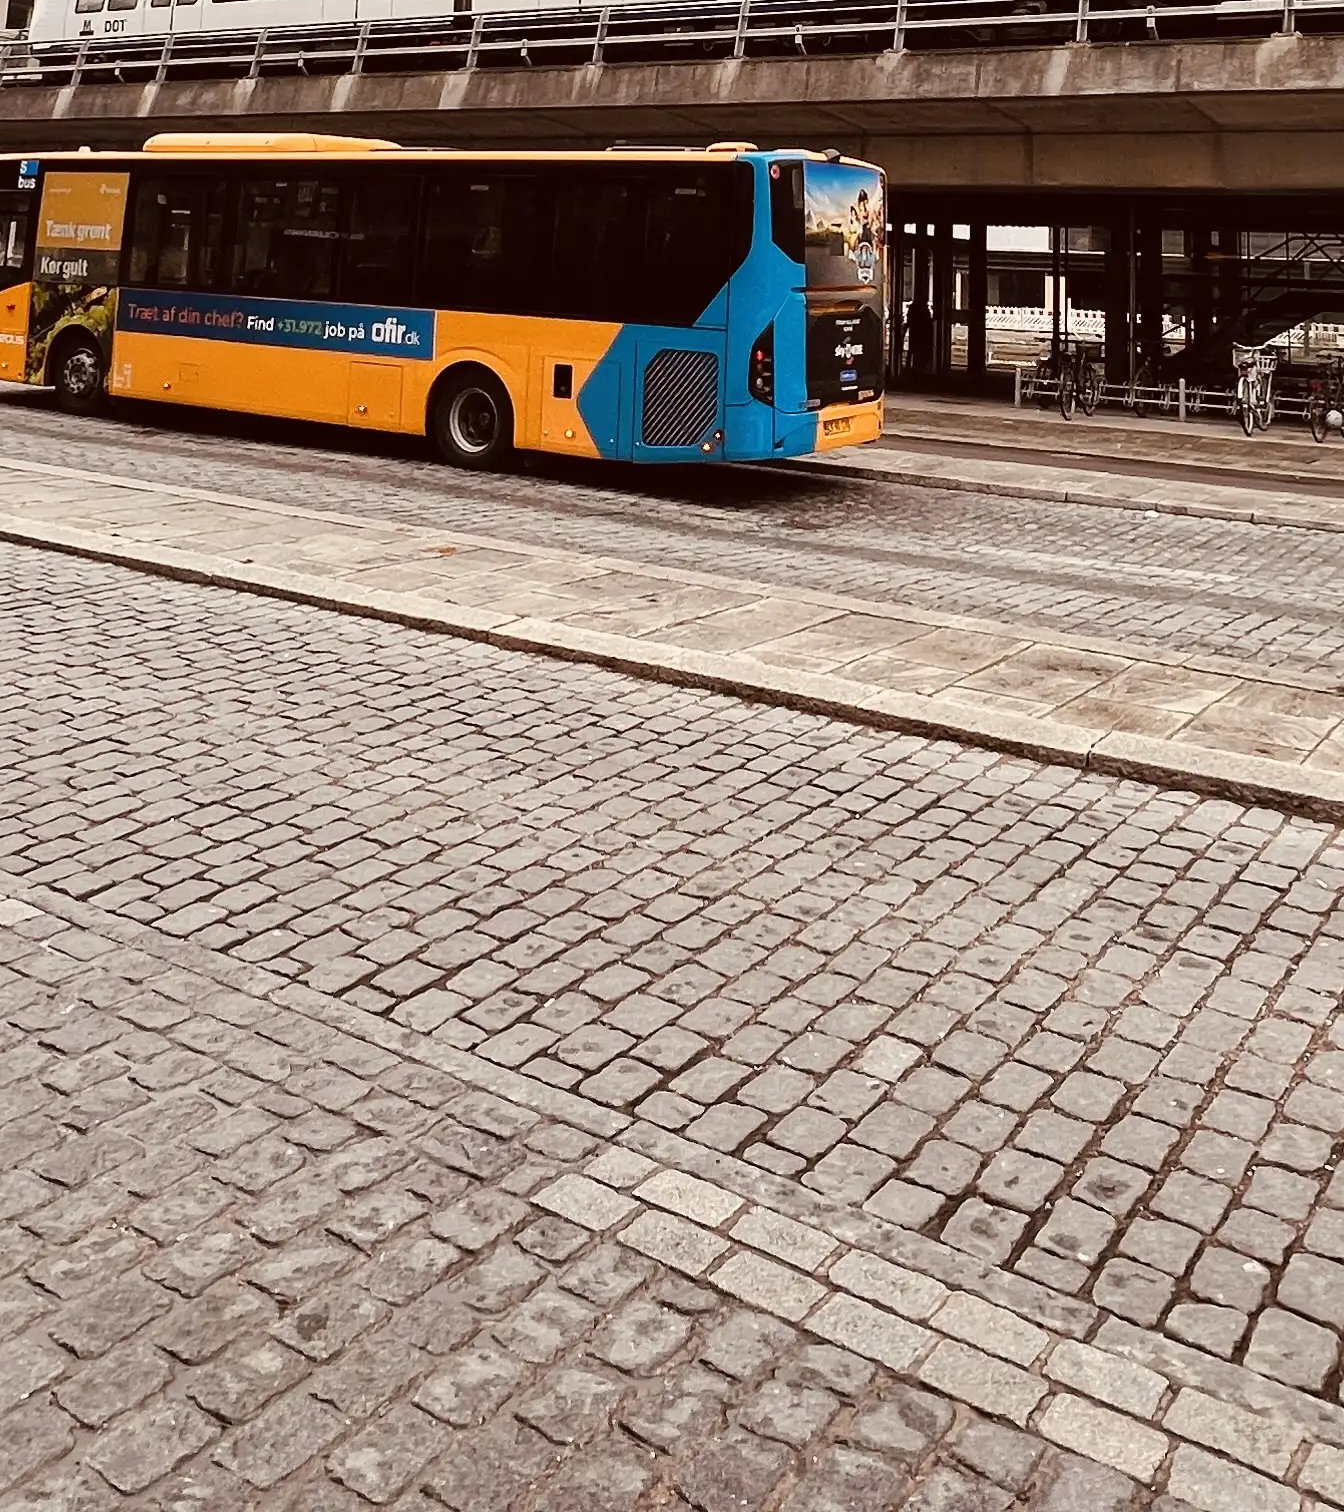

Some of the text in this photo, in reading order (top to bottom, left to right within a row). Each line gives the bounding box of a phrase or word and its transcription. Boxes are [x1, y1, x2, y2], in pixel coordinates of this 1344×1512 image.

[104, 19, 125, 32] DOT
[19, 160, 28, 175] S
[18, 175, 36, 189] bus
[128, 303, 160, 321] Træt
[162, 306, 176, 322] af
[178, 306, 200, 325] din
[204, 309, 244, 329] chef?
[246, 315, 275, 332] Find
[323, 321, 346, 340] job
[348, 323, 366, 341] på
